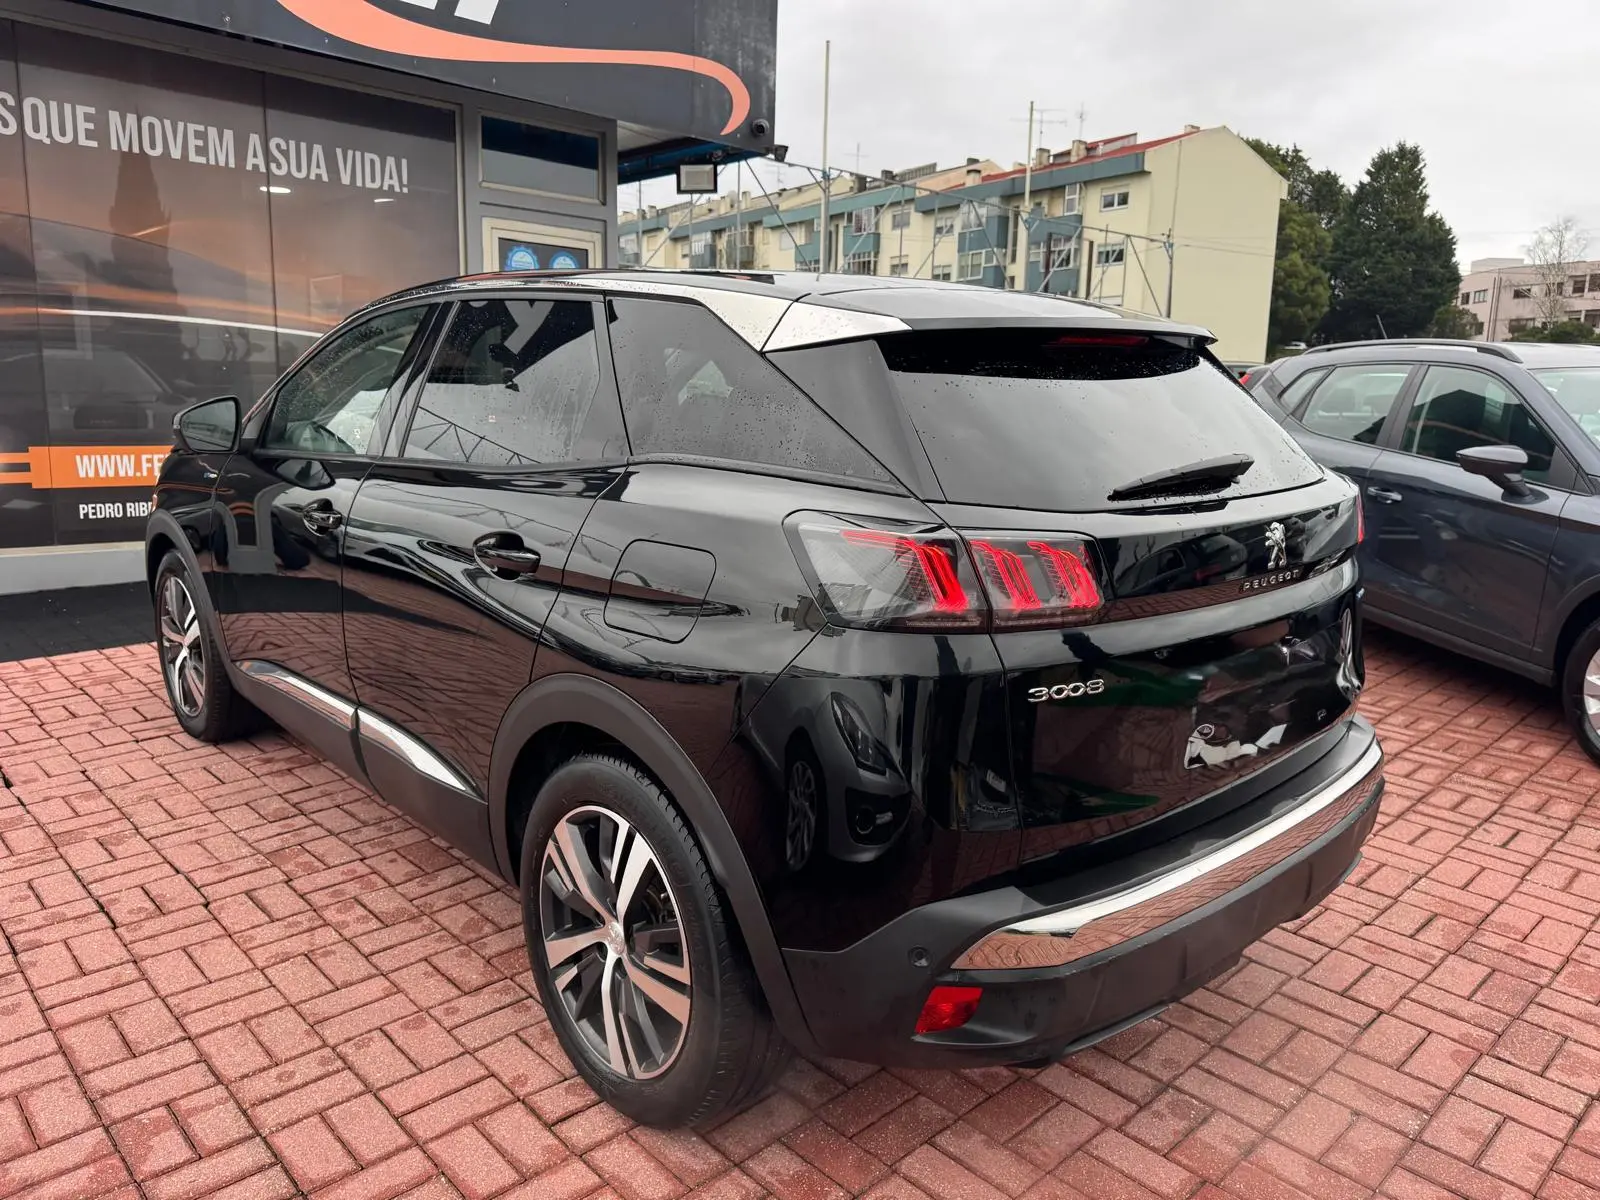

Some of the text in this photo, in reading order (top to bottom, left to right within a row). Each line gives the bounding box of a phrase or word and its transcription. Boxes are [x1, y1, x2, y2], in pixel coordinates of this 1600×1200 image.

[108, 109, 236, 169] MOVEM
[335, 147, 409, 194] VIDA!
[79, 503, 123, 519] PEDRO
[1243, 569, 1299, 590] PEUGEOT
[1027, 679, 1105, 702] 3008
